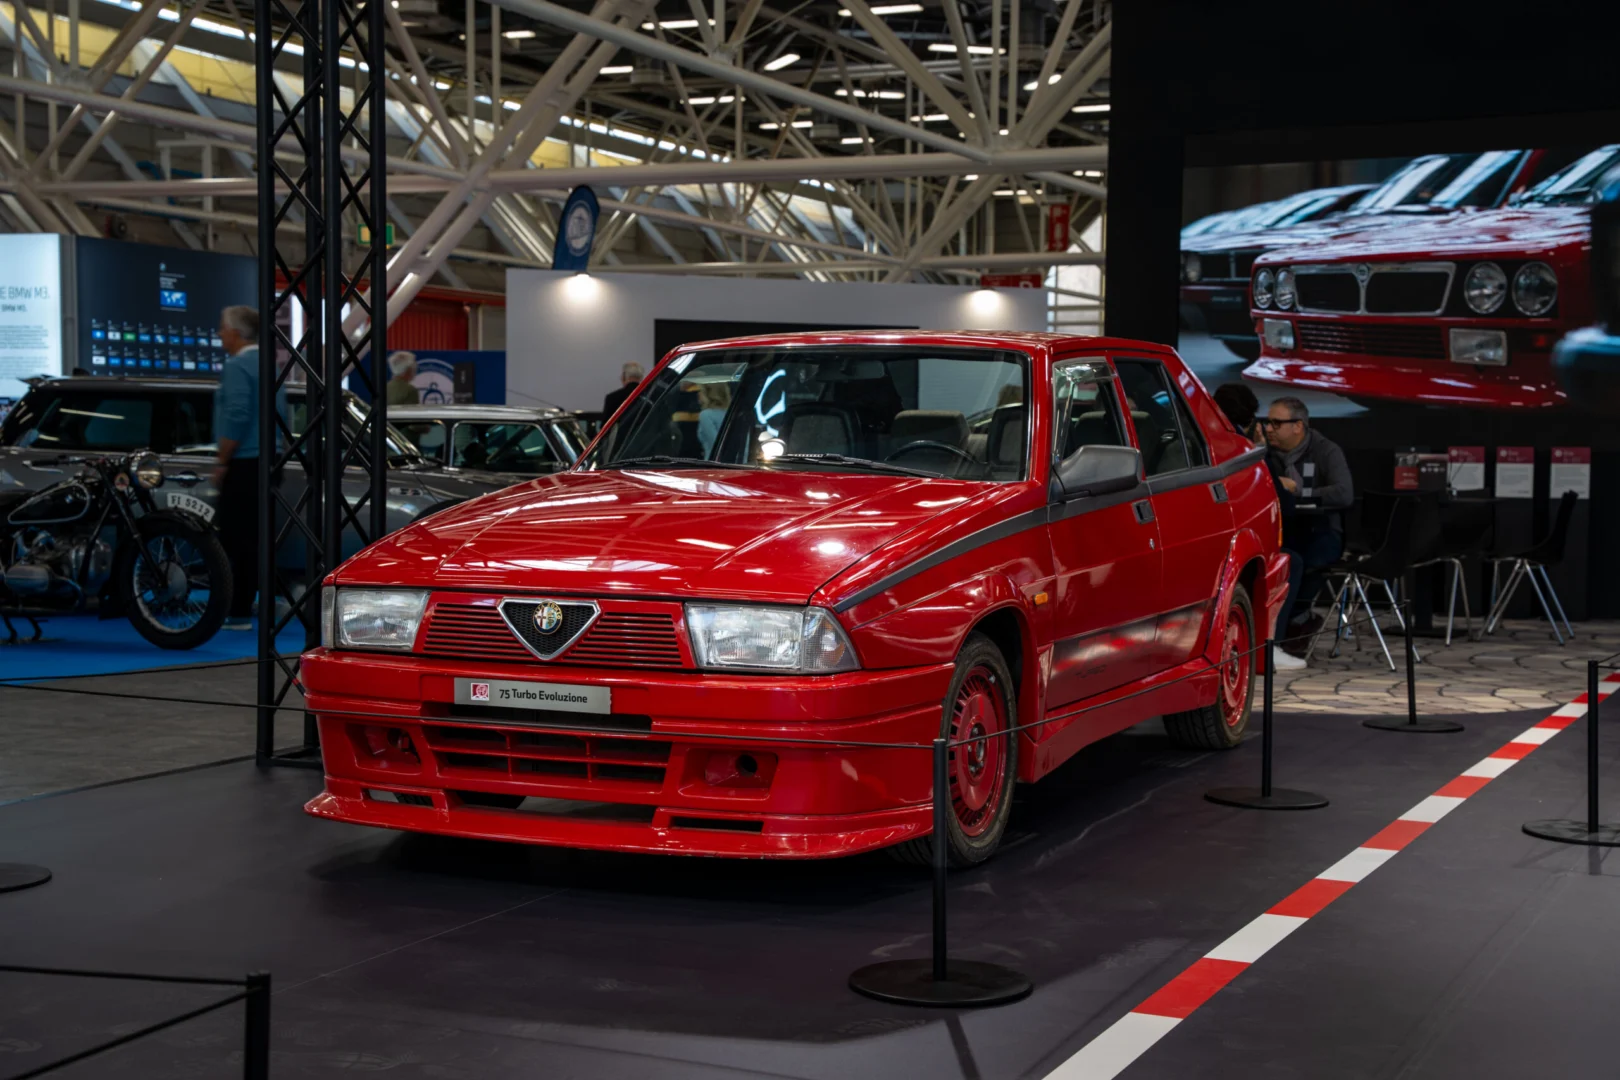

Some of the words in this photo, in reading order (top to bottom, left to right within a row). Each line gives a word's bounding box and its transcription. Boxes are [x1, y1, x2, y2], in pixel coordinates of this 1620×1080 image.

[8, 287, 32, 299] BMW
[185, 498, 211, 518] 5212
[499, 689, 510, 699] 75
[511, 688, 537, 700] Turbo
[538, 690, 588, 704] Evoluzione
